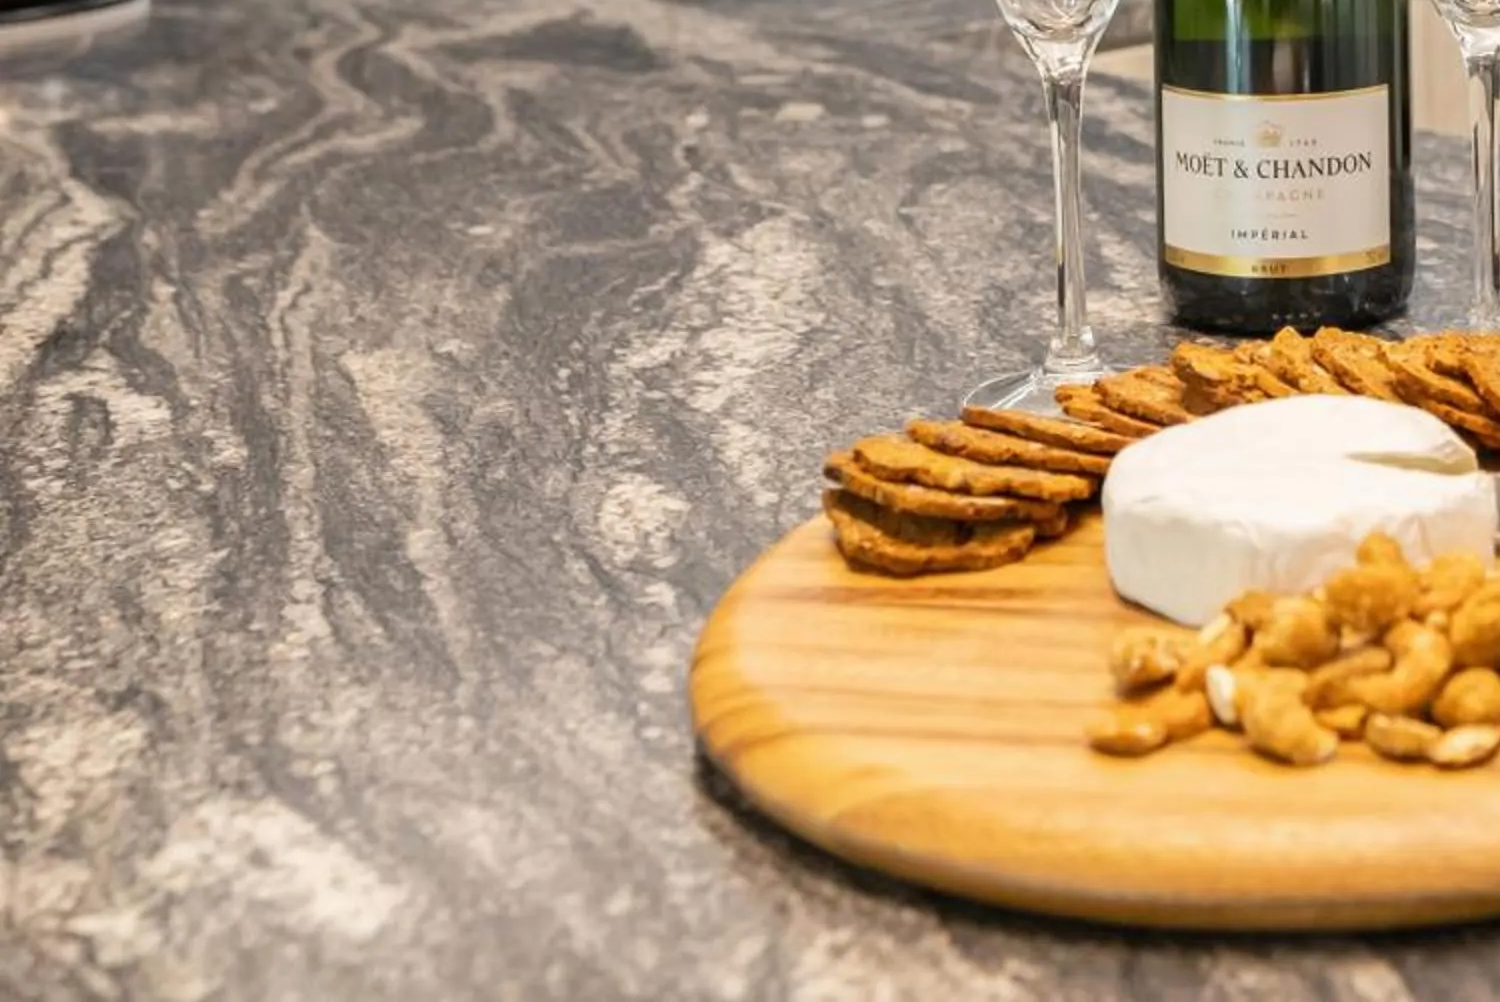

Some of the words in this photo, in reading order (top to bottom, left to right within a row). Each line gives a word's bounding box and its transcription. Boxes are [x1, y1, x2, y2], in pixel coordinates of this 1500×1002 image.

[1175, 151, 1229, 177] MOËT
[1233, 162, 1250, 179] &
[1257, 151, 1373, 180] CHANDON
[1213, 187, 1325, 202] CPAGNE
[1231, 227, 1310, 241] IMPÉRIAL
